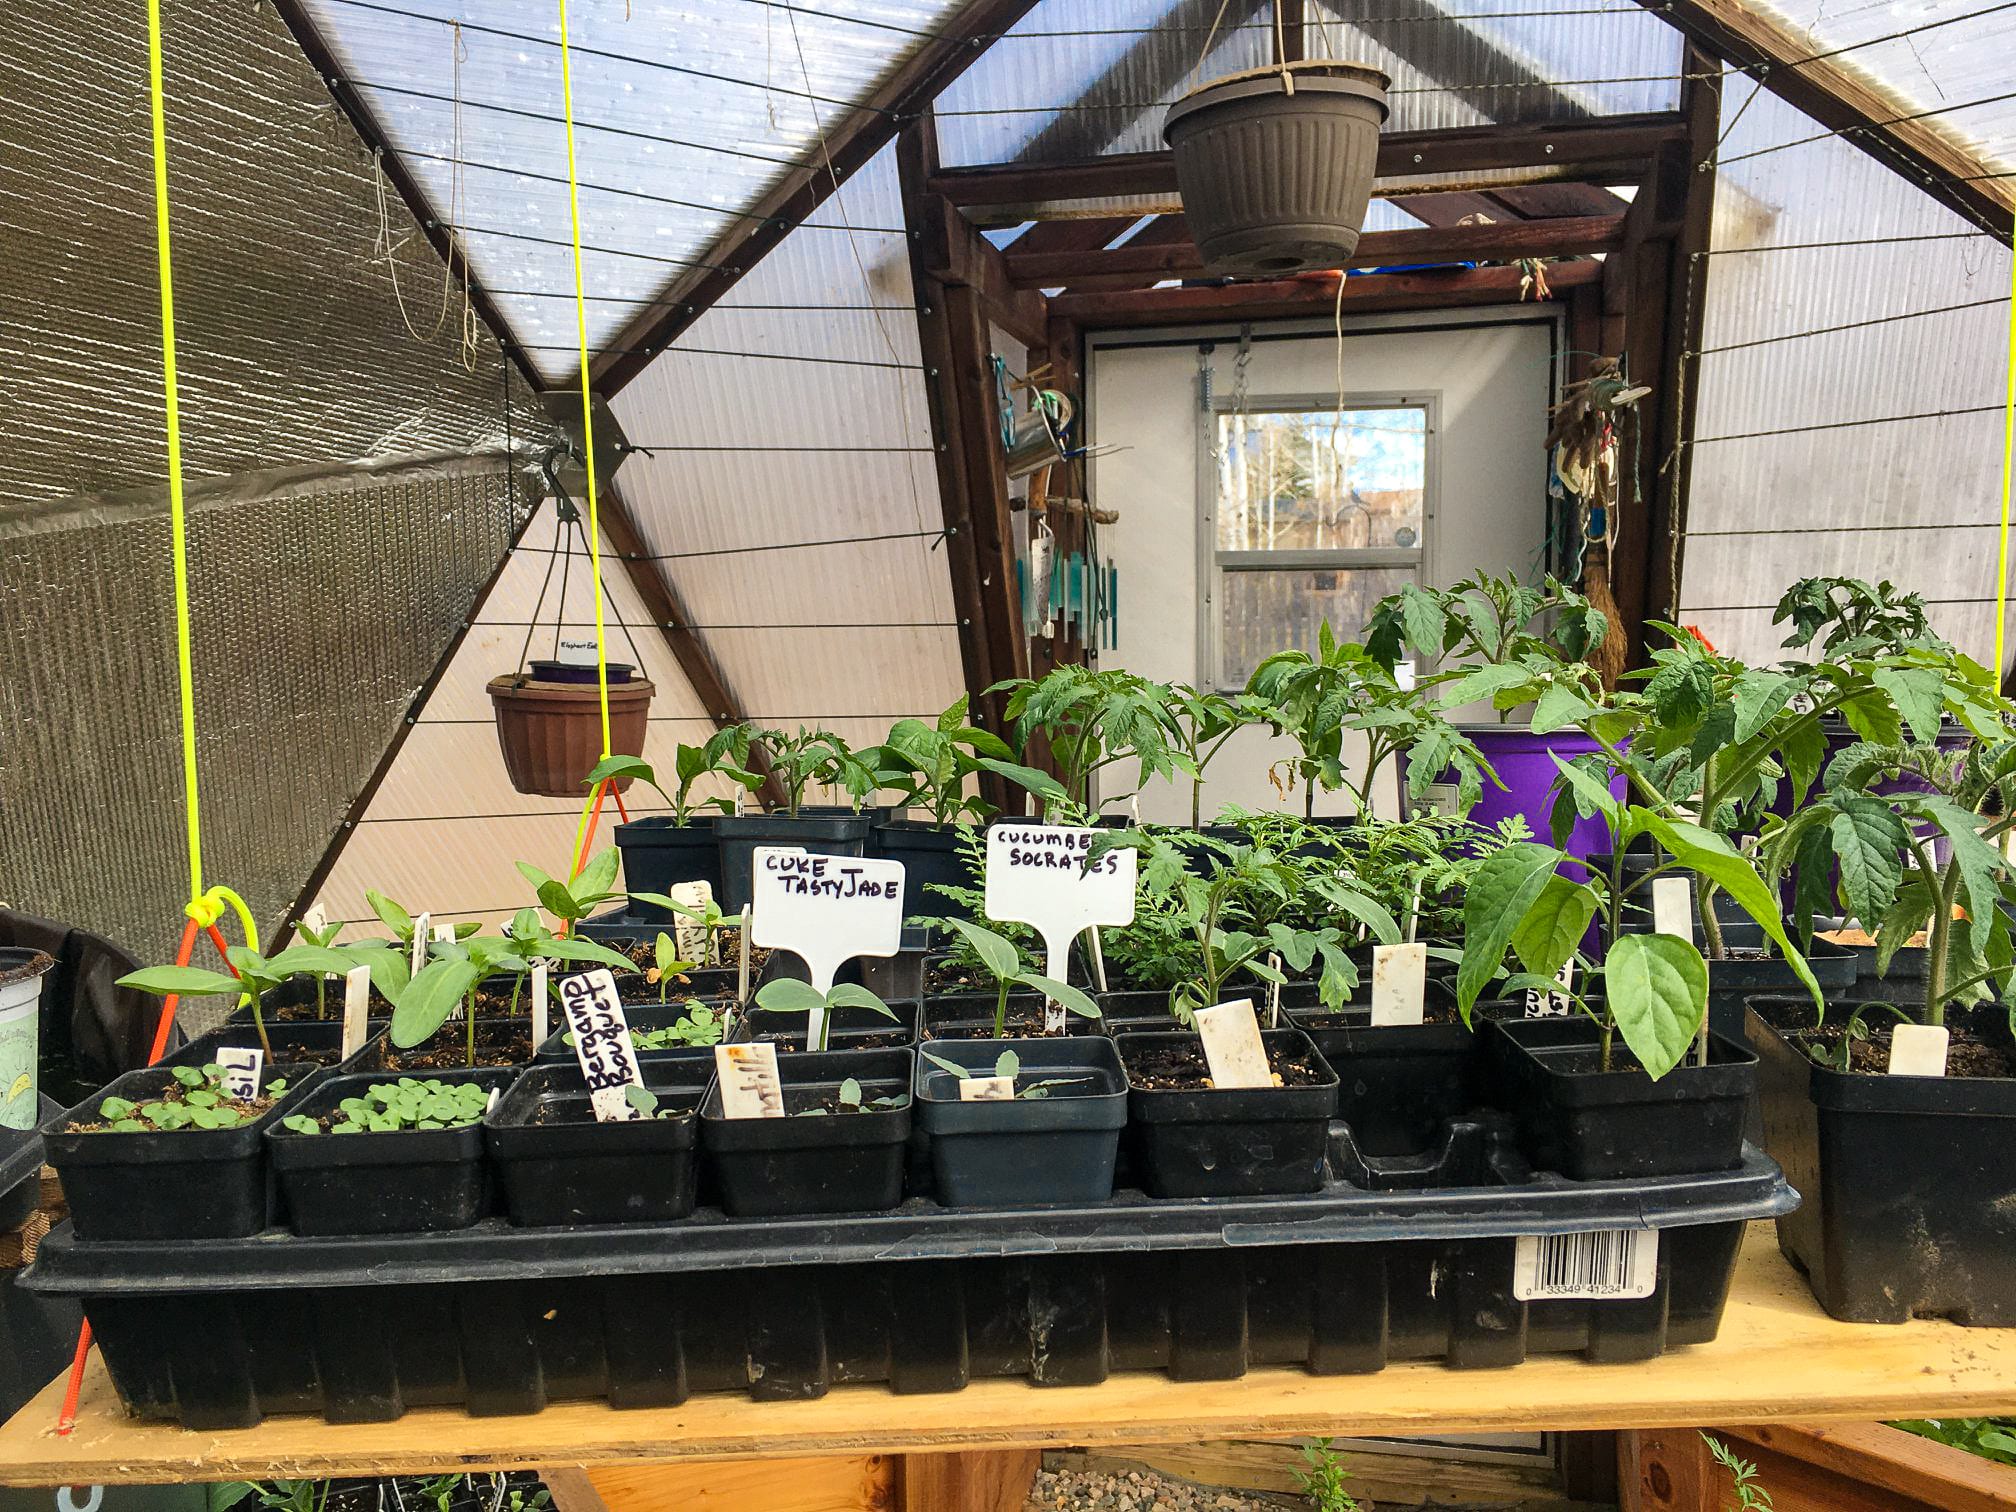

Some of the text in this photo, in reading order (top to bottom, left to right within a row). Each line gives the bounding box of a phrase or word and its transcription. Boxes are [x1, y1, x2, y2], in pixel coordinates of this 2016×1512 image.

[998, 831, 1091, 850] CUCUMBE
[766, 855, 829, 877] CUKE
[1546, 1285, 1581, 1295] 33349
[1586, 1284, 1622, 1295] 41234
